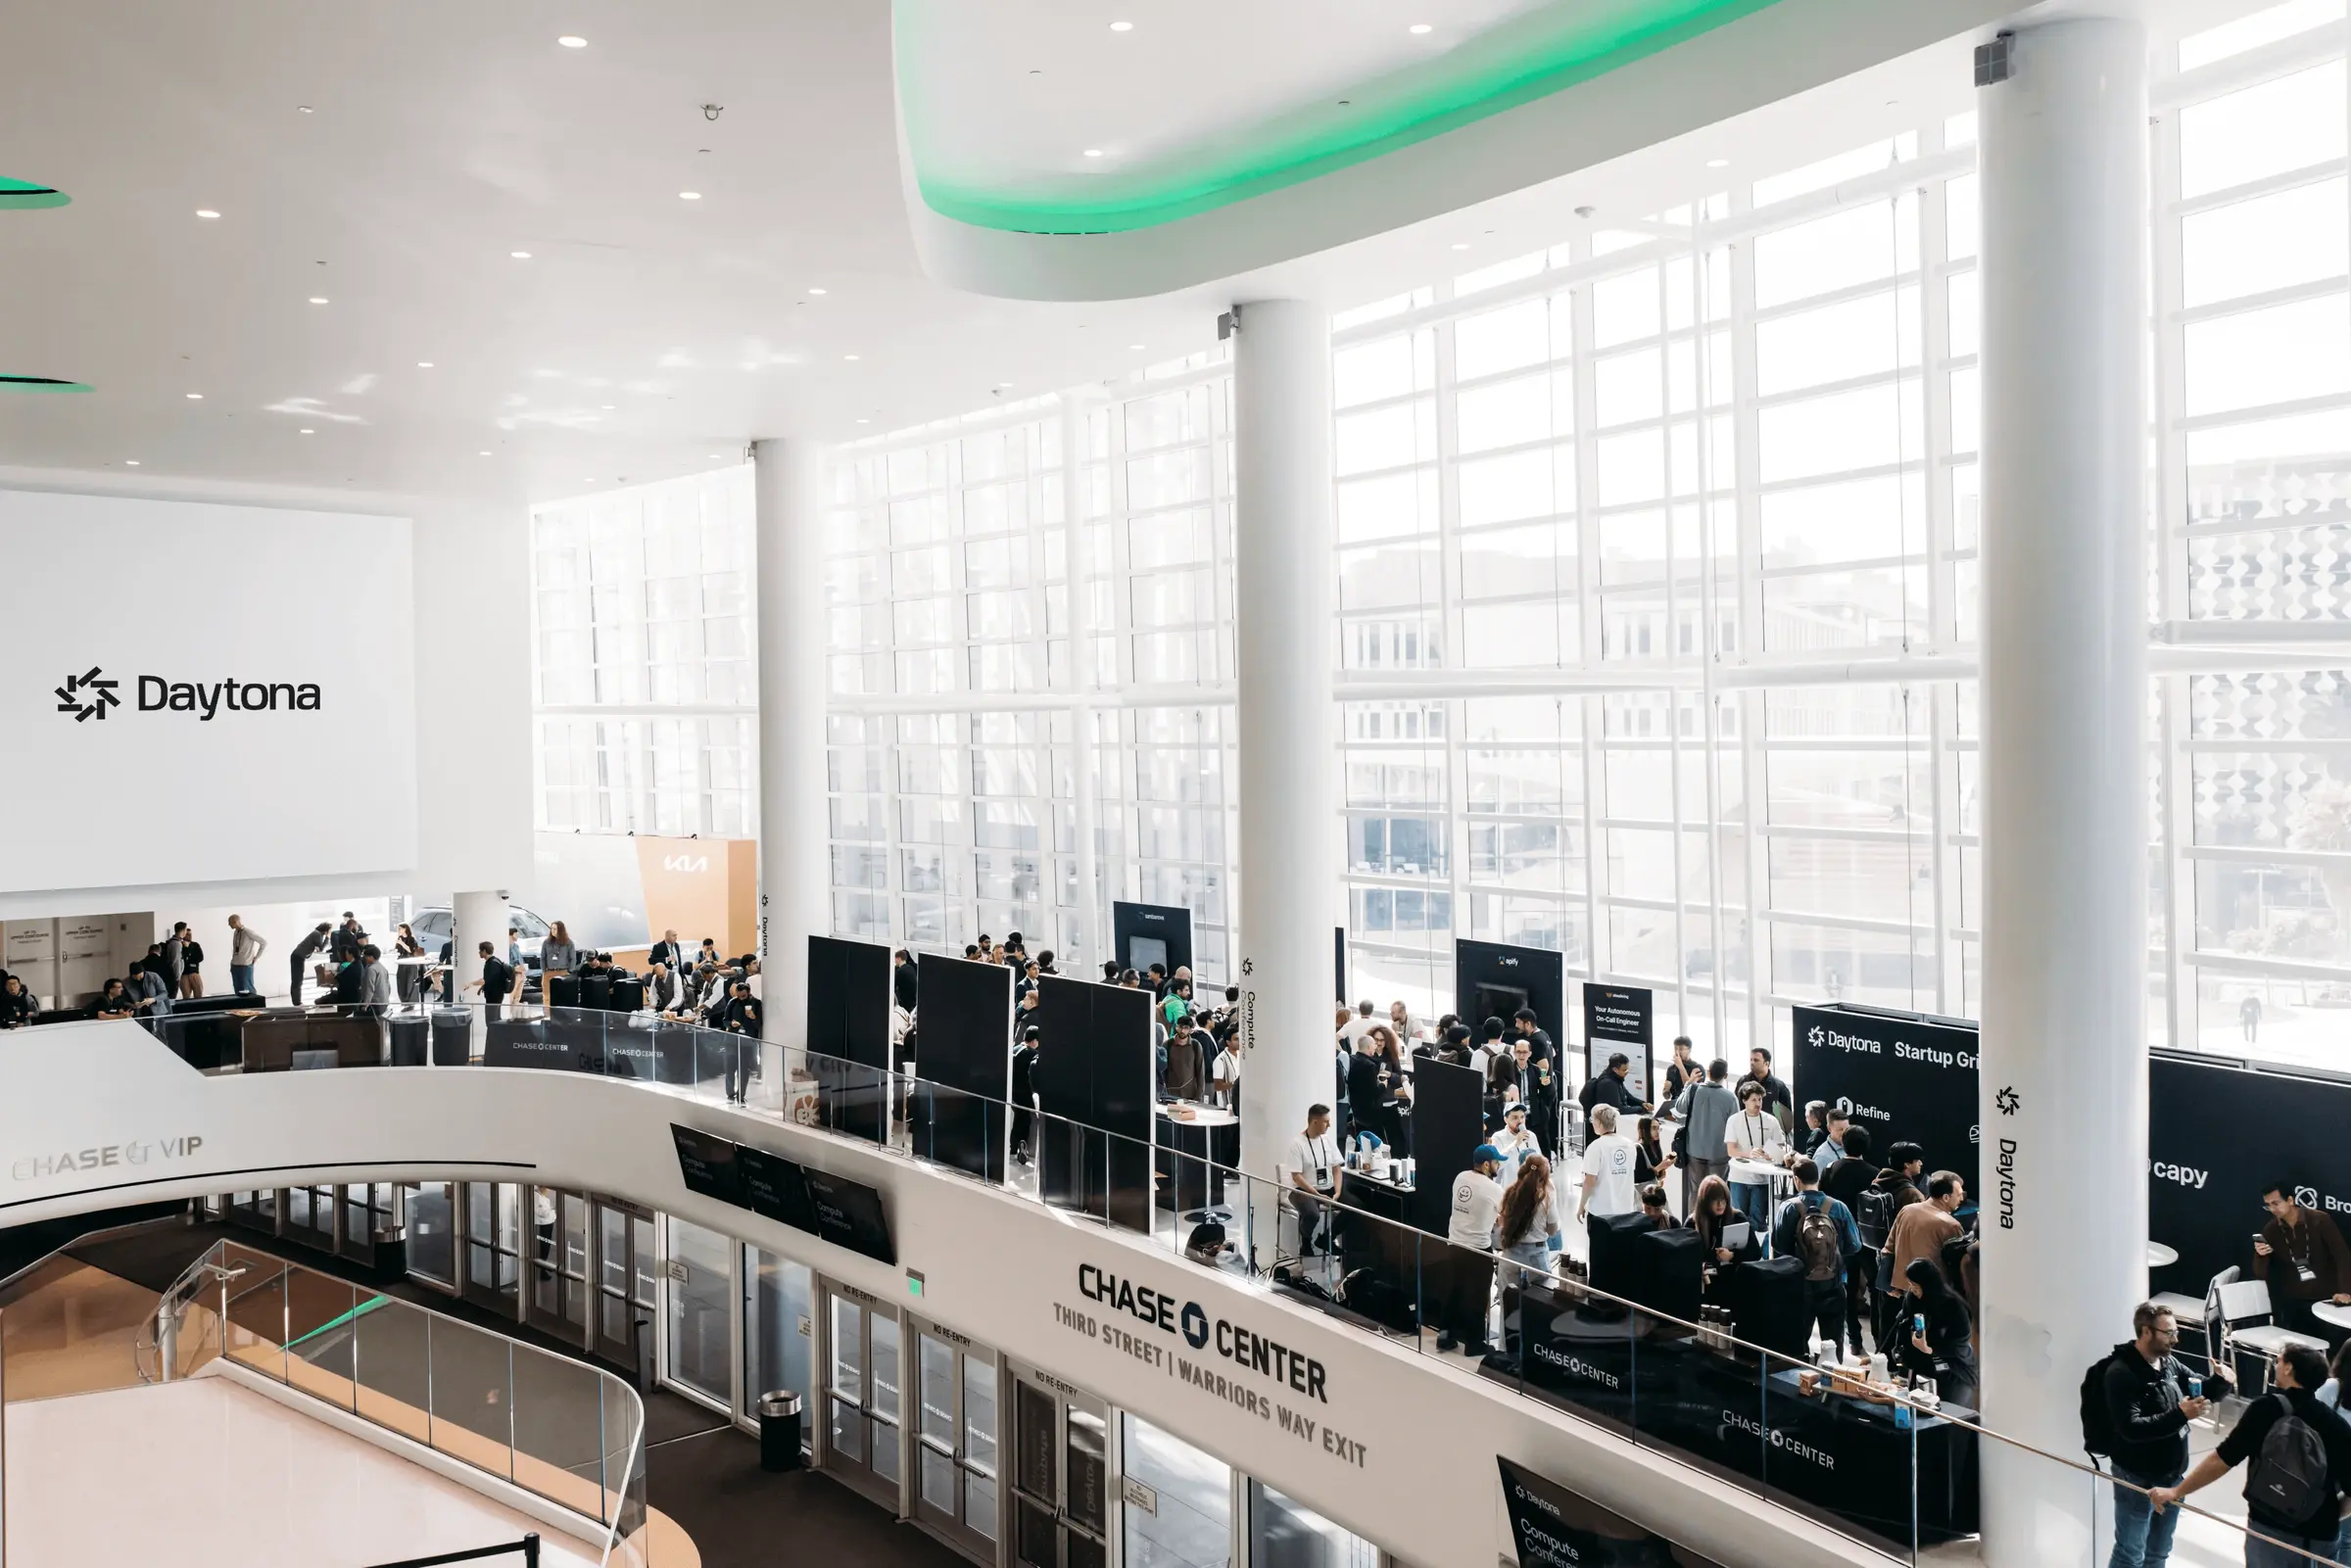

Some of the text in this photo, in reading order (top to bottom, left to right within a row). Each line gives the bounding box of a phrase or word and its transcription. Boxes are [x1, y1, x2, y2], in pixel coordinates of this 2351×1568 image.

[138, 675, 321, 721] Daytona
[664, 855, 708, 872] KIA
[1246, 991, 1255, 1049] Compute
[1596, 1015, 1640, 1026] On-Call Engineer
[1607, 1007, 1641, 1017] Autonomous
[612, 1048, 636, 1057] CHASE
[1828, 1030, 1979, 1069] Daytona Startup Gri
[1855, 1104, 1891, 1120] Refine
[13, 1136, 203, 1180] CHASE VIP
[1996, 1138, 2017, 1230] Daytona
[2154, 1162, 2208, 1189] capy
[851, 1290, 878, 1305] RE-ENTRY
[934, 1323, 971, 1348] NO RE-ENTRY
[1079, 1263, 1327, 1403] CHASE CENTER
[1533, 1343, 1618, 1389] CHASE CENTER
[1035, 1370, 1078, 1398] NO RE-ENTRY
[1053, 1302, 1097, 1338] THIRD
[1102, 1324, 1163, 1367] STREET
[1177, 1357, 1271, 1420] WARRIORS
[1276, 1404, 1316, 1443] WAY
[1322, 1427, 1367, 1468] EXIT
[1723, 1409, 1835, 1470] CHASE CENTER
[1526, 1491, 1560, 1516] Daytona
[1520, 1518, 1579, 1560] Compute
[1524, 1537, 1578, 1568] Confere
